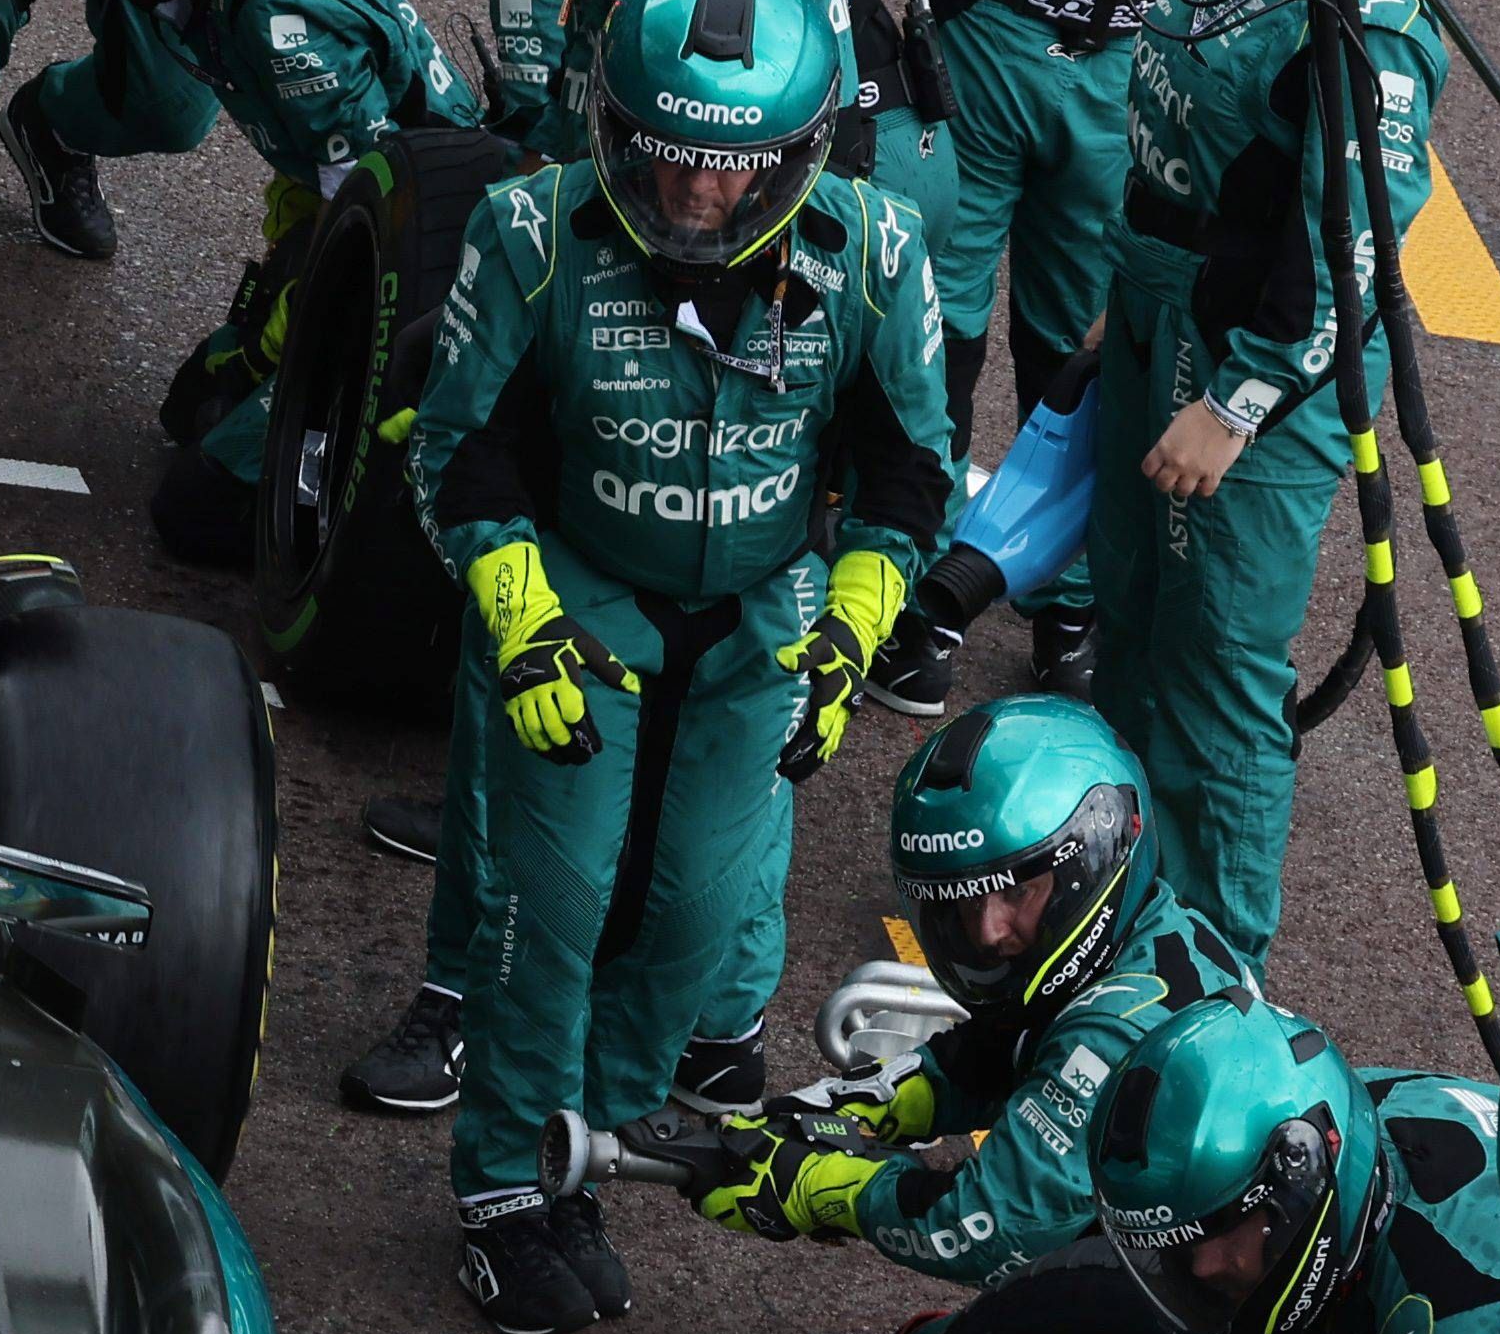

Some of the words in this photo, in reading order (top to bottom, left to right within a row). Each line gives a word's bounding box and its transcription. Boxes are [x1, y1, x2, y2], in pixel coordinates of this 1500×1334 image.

[271, 51, 323, 74] EPOS
[277, 71, 340, 101] PIRELLI
[656, 90, 763, 126] aramco
[1377, 118, 1414, 144] POS
[629, 130, 697, 170] ASTON
[701, 147, 783, 172] MARTIN
[793, 249, 846, 285] PERONI
[592, 326, 671, 351] JCB
[344, 270, 399, 514] Cinturato
[592, 377, 671, 392] SentinelOne
[592, 408, 809, 460] cognizant
[592, 464, 801, 528] aramco
[900, 828, 985, 854] aramco
[938, 868, 1017, 902] MARTIN
[498, 893, 520, 987] BRADBURY
[1040, 904, 1115, 996] cognizant
[1040, 1080, 1088, 1130] EPOS
[1016, 1096, 1074, 1157] PIRELLI
[1131, 1220, 1206, 1250] MARTIN
[1280, 1235, 1332, 1333] cognizant
